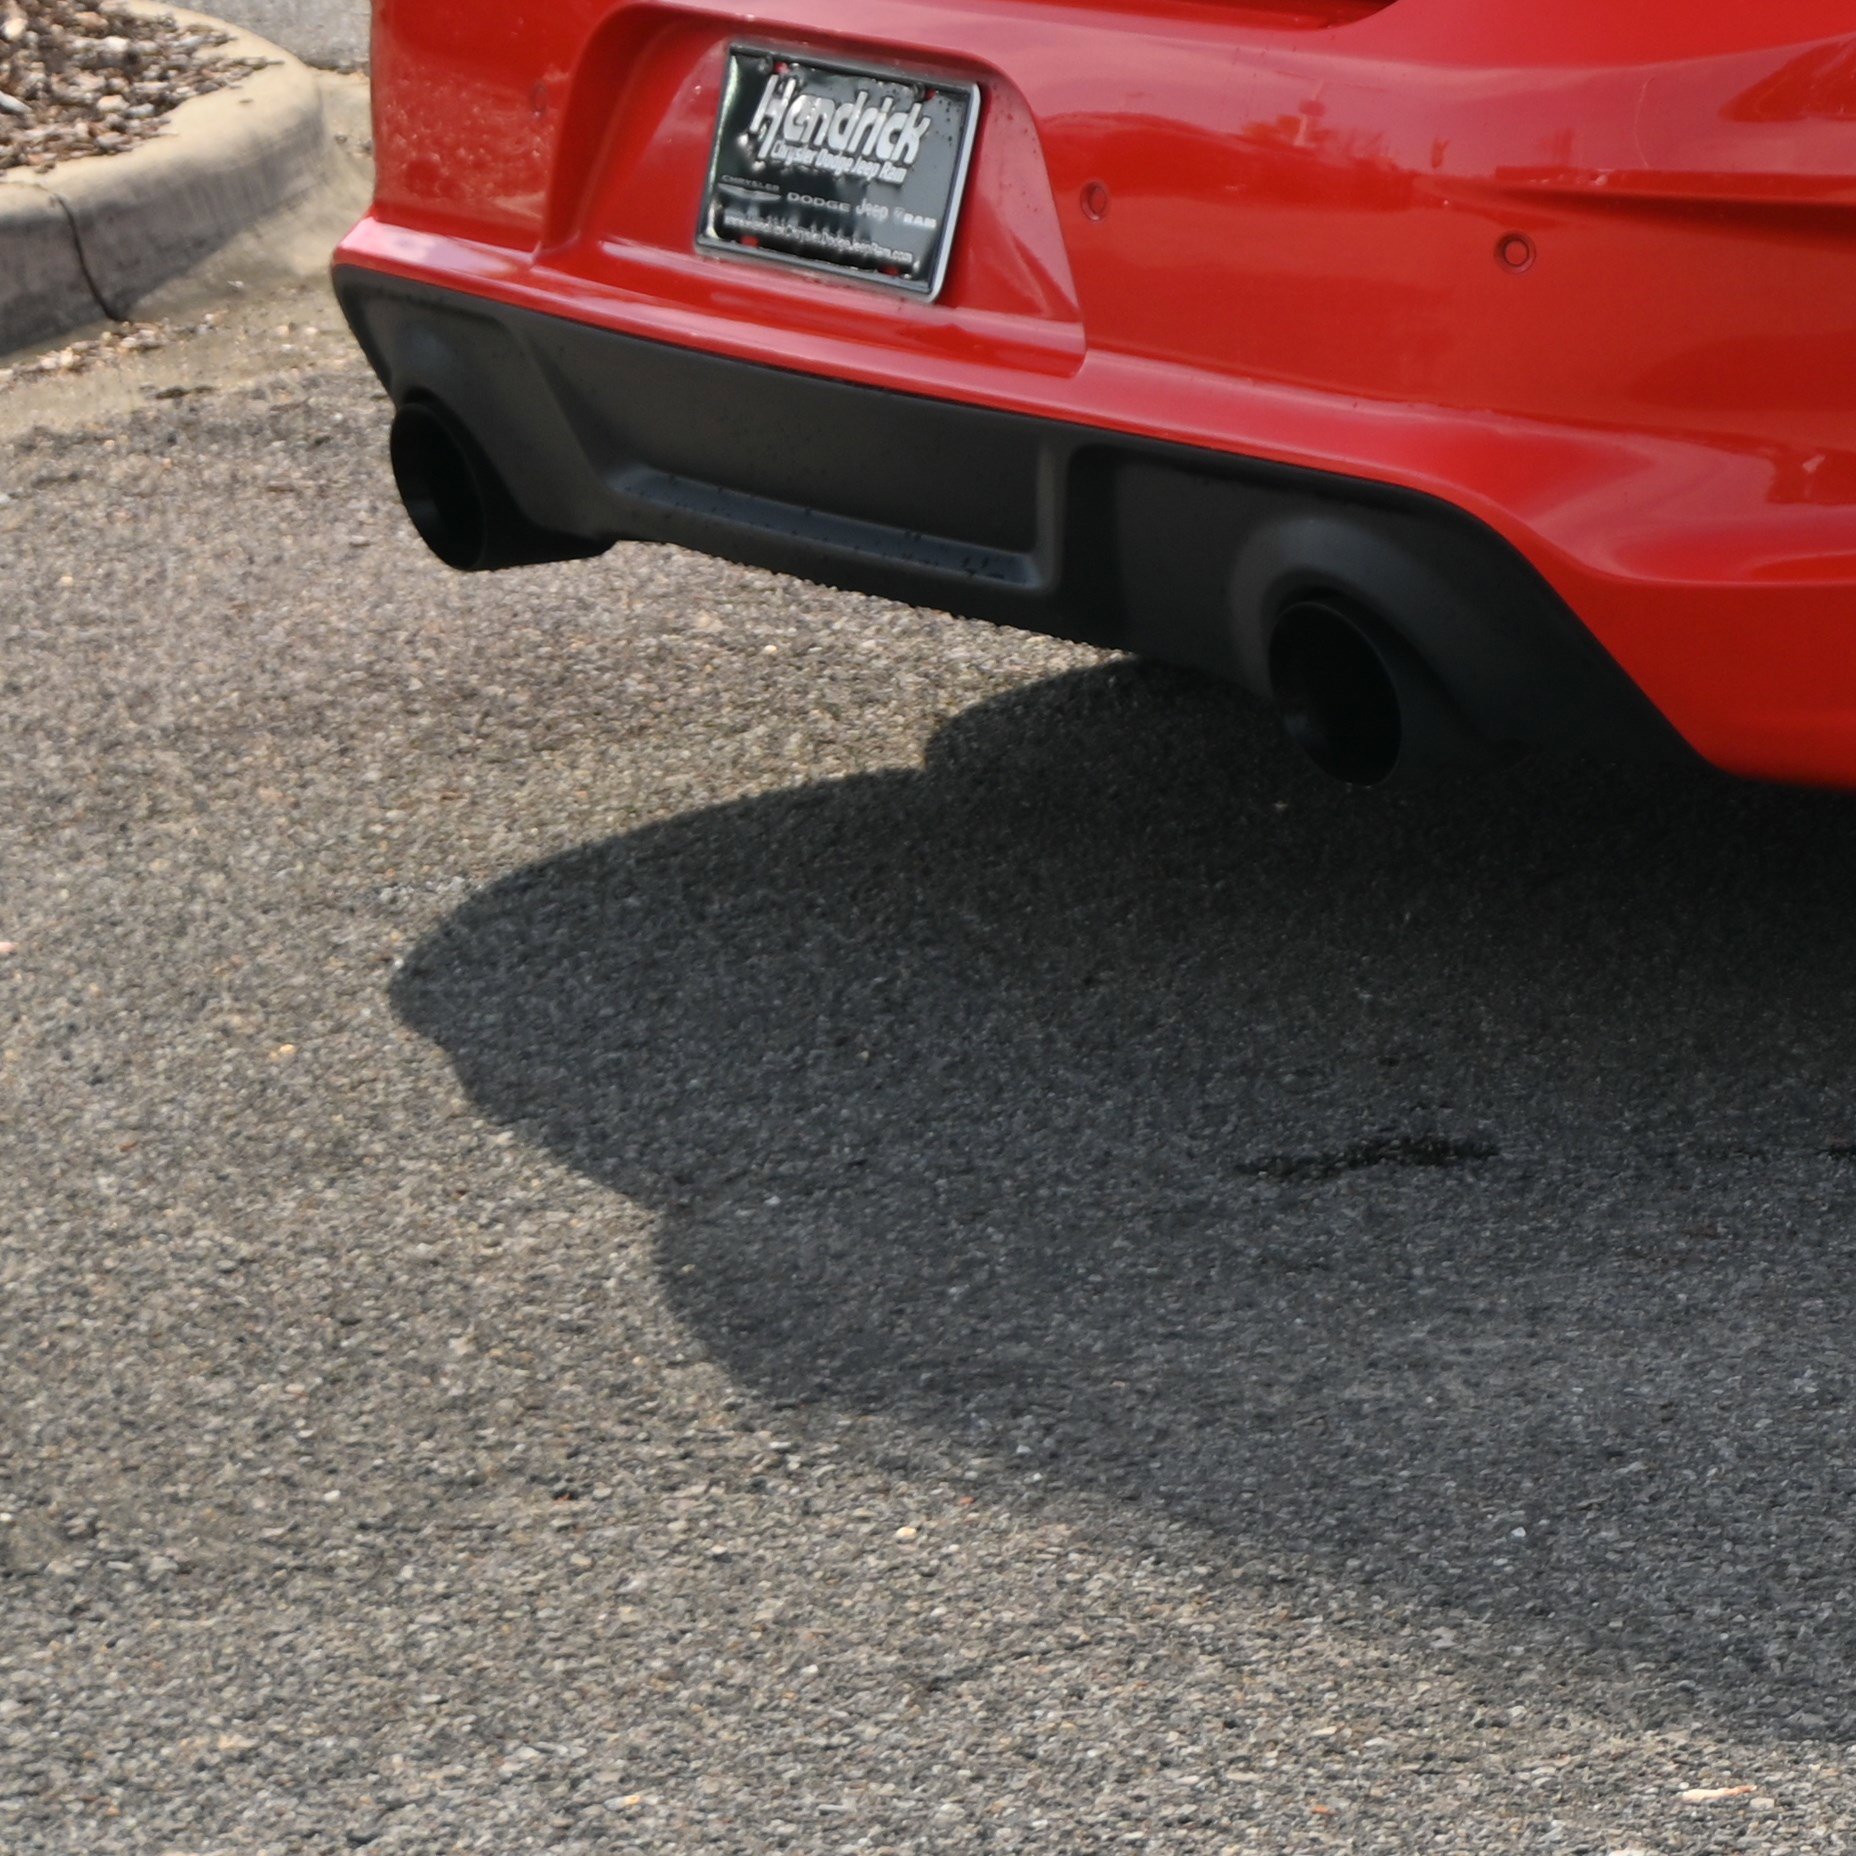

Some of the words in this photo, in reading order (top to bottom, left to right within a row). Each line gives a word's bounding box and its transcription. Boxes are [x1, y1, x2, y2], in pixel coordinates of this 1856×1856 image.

[750, 74, 932, 165] Hendrick
[770, 140, 817, 167] Chrysler
[815, 148, 853, 176] Dodge
[851, 156, 881, 181] Jeep
[878, 161, 908, 184] Ram
[722, 174, 780, 192] CHRYSLER
[786, 192, 851, 213] DODGE
[856, 198, 889, 222] Jeep
[903, 213, 938, 229] RAM
